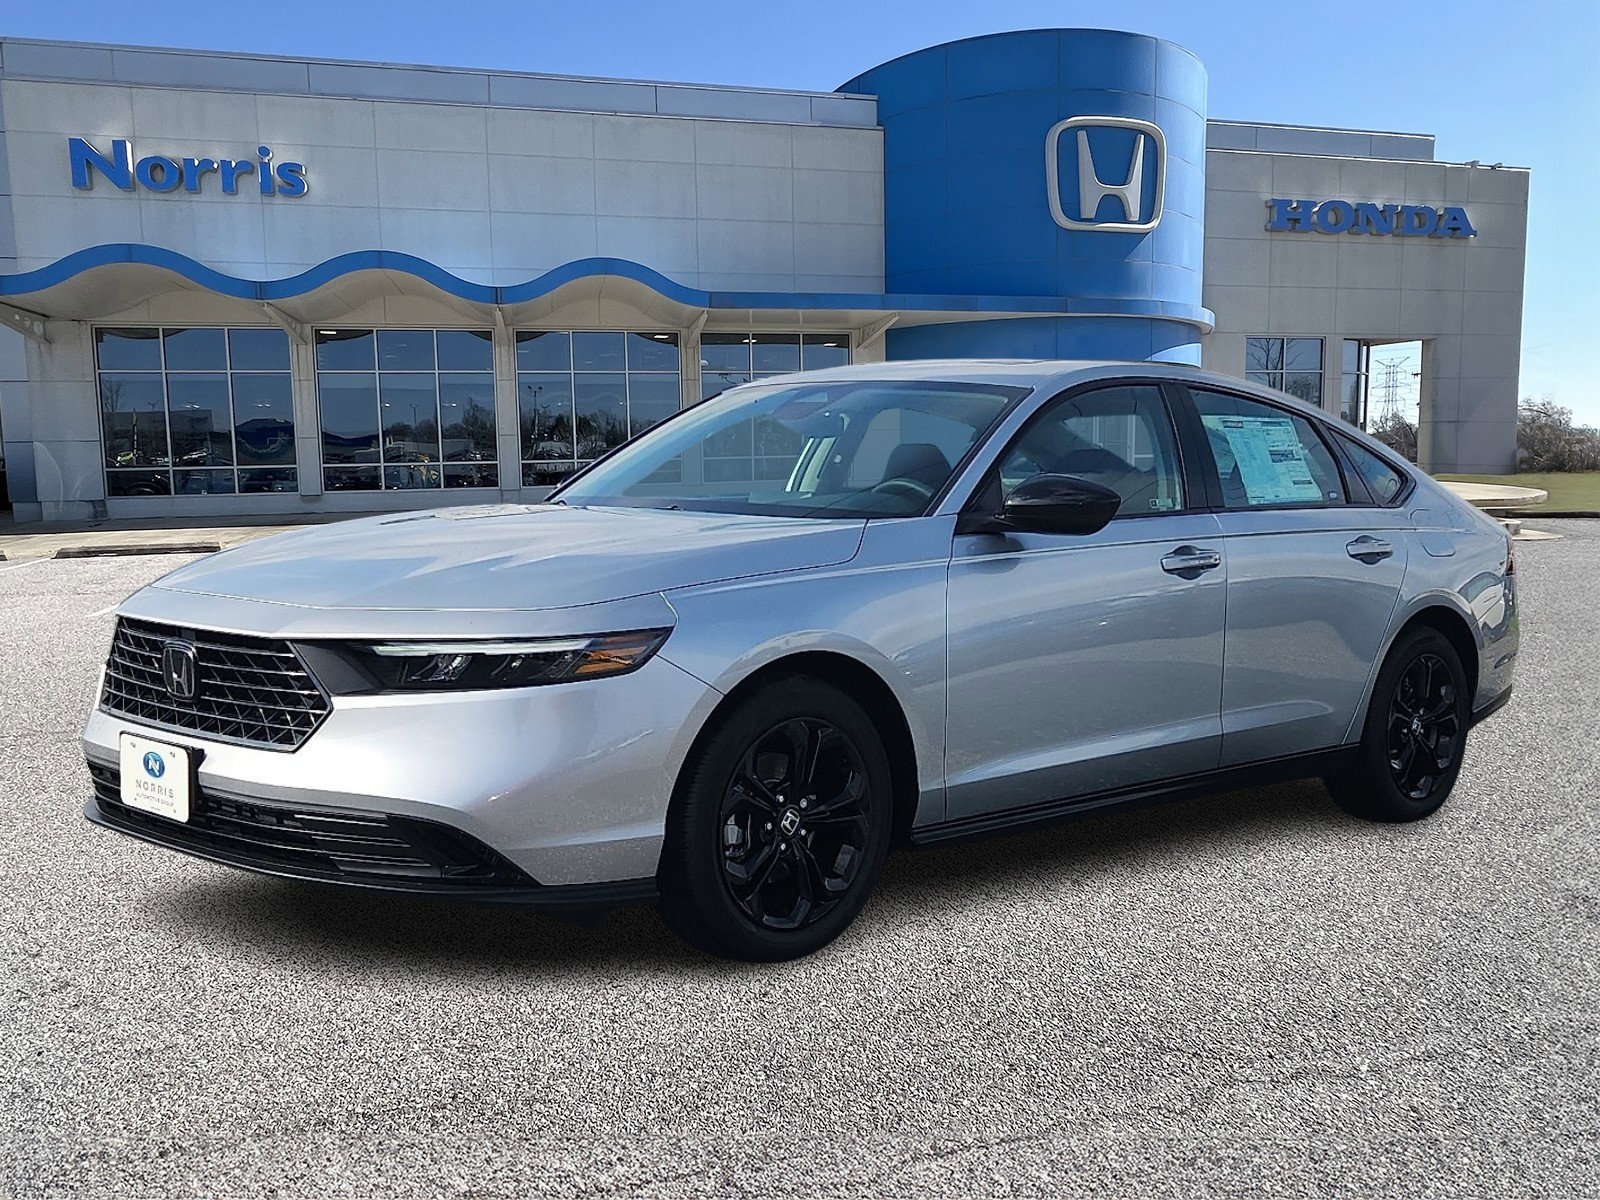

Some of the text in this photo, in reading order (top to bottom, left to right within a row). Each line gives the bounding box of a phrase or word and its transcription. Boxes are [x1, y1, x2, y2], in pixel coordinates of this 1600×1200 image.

[68, 137, 309, 197] Norris
[1265, 198, 1478, 239] HONDA
[135, 779, 174, 799] NORRIS
